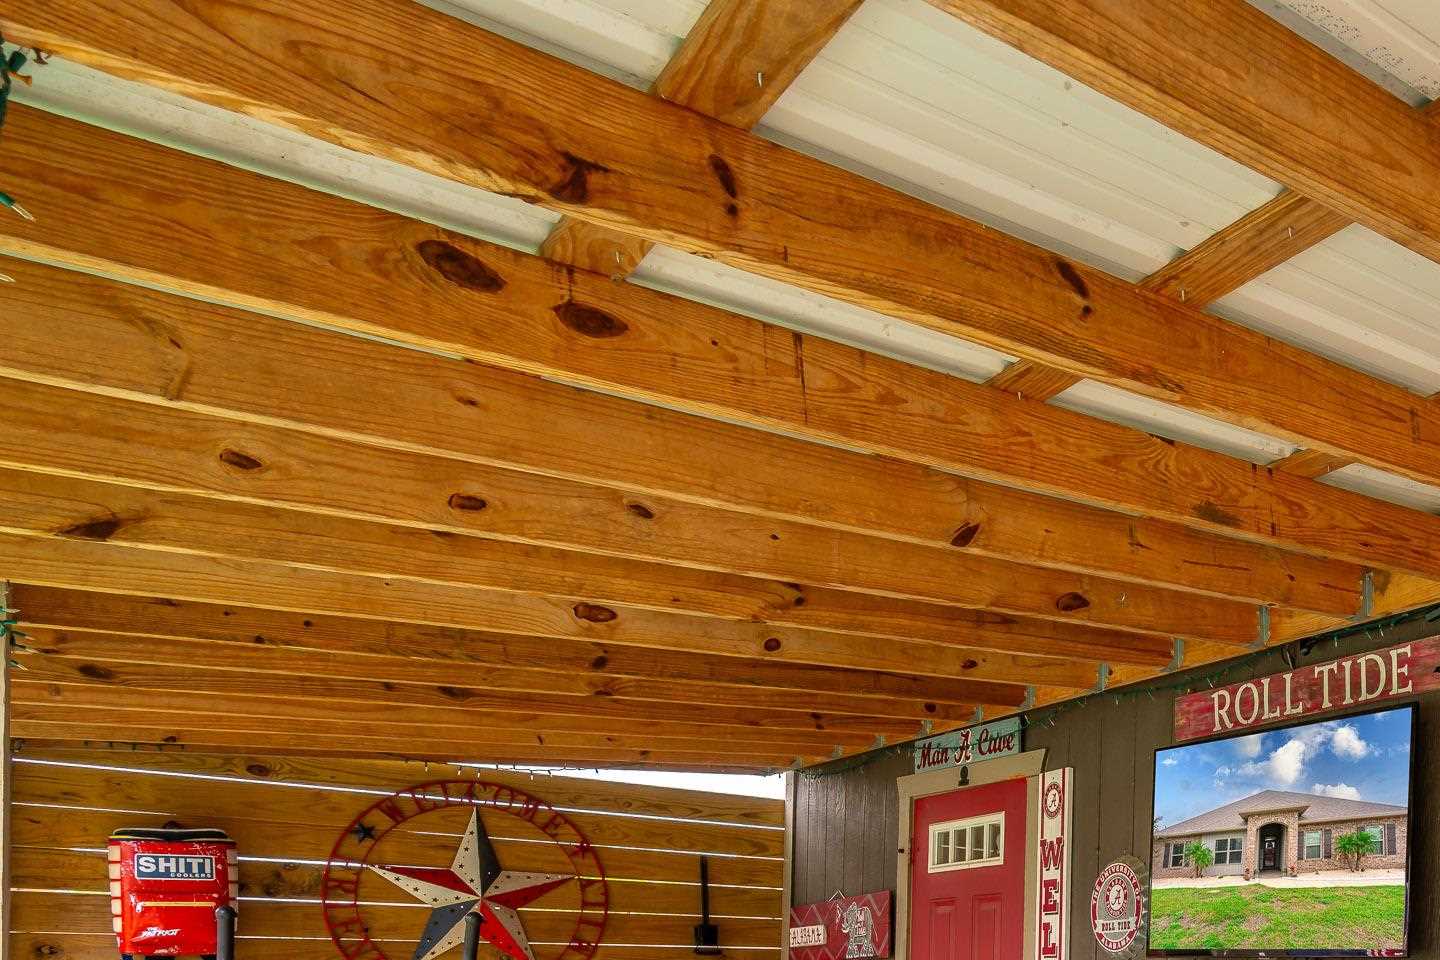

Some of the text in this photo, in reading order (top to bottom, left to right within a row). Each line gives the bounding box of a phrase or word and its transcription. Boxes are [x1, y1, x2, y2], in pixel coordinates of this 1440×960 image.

[1211, 644, 1413, 732] ROLL TIDE
[917, 741, 949, 769] Man
[976, 728, 1015, 756] Cave
[378, 779, 572, 839] WELCOME
[138, 856, 212, 874] SHITI
[1100, 864, 1137, 883] UNIVERSITY
[1101, 920, 1131, 932] ROLL TIDE
[1101, 936, 1132, 950] ALABAMA
